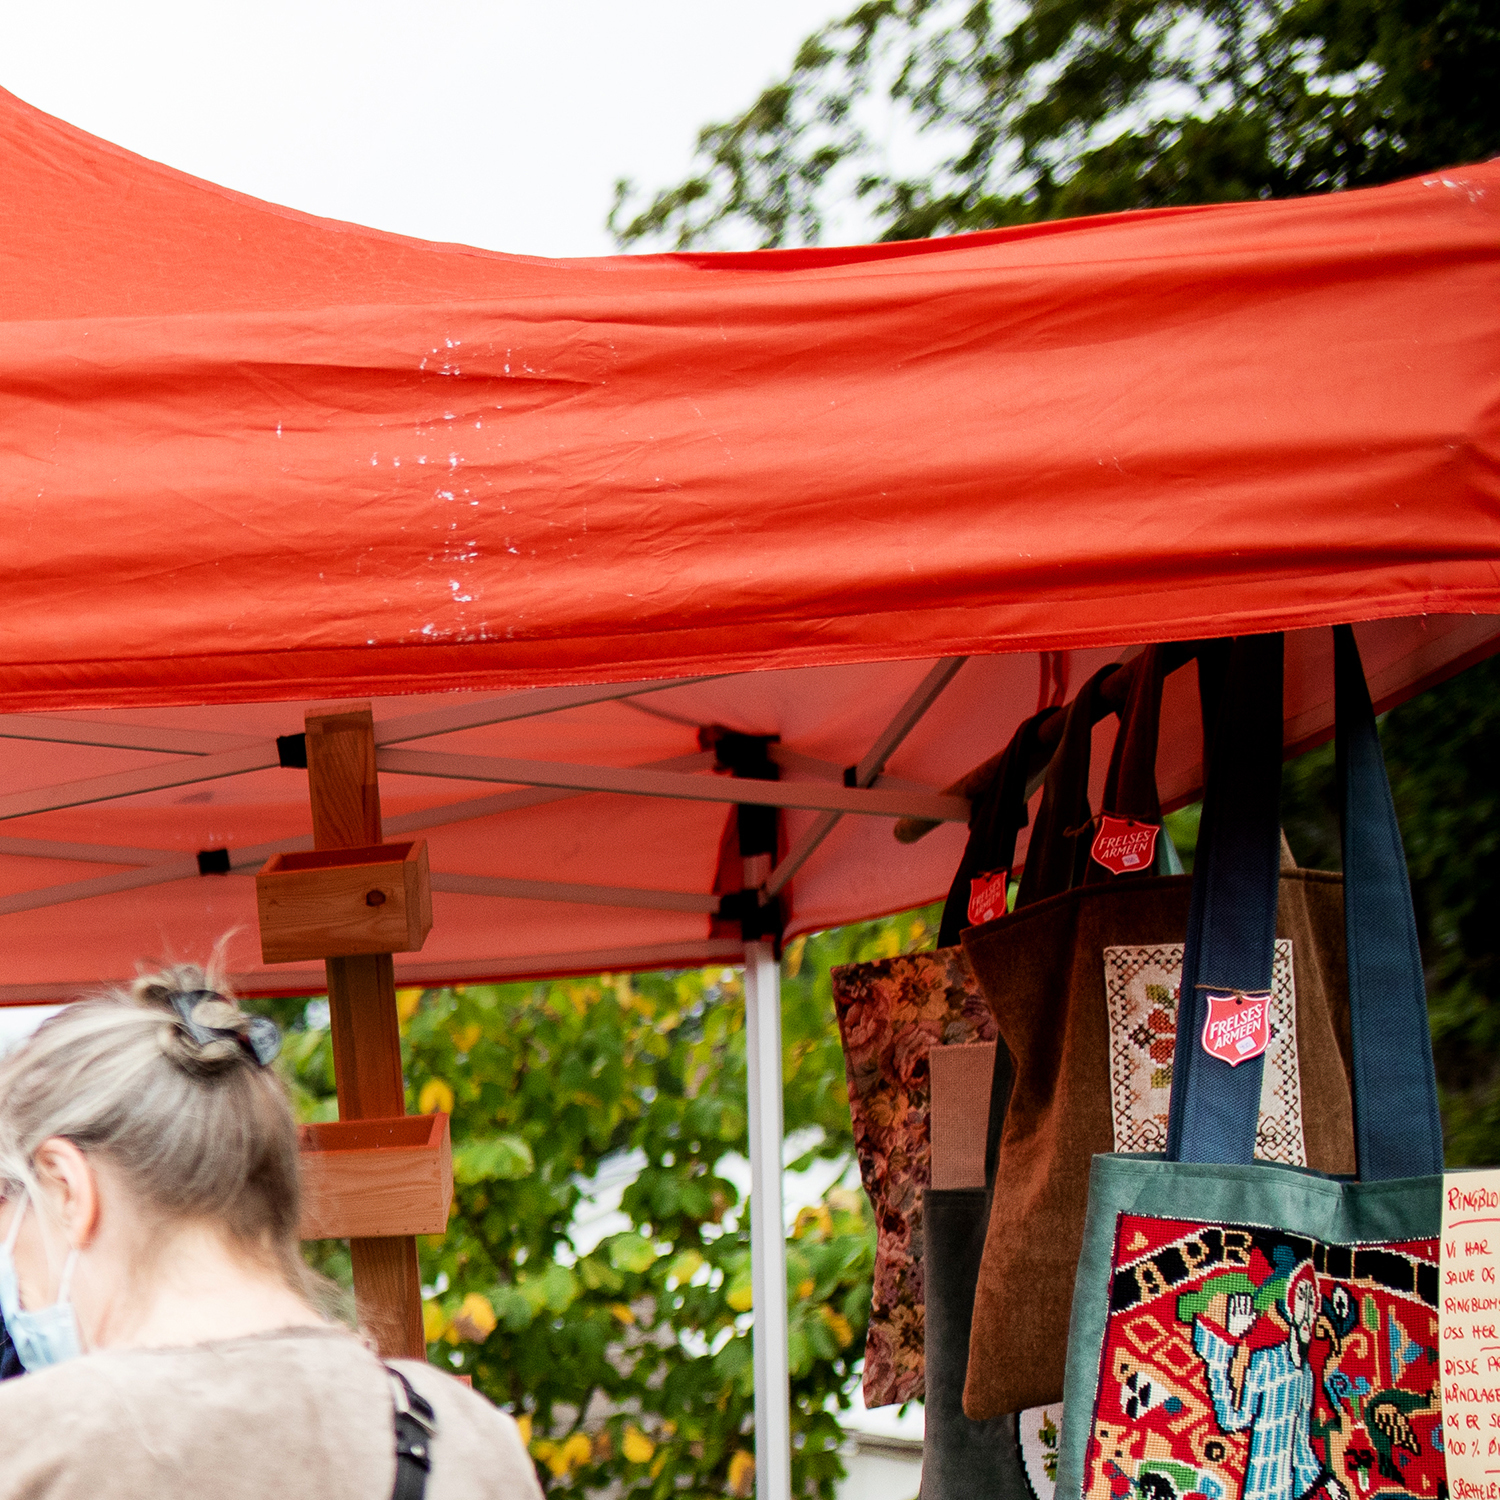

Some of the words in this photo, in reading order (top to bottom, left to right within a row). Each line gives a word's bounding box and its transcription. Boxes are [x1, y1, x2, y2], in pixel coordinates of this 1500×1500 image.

[1101, 842, 1149, 860] ARMEEN
[1213, 1018, 1262, 1051] ARMEEN
[1465, 1239, 1493, 1257] HAR
[1445, 1269, 1475, 1286] SALVE
[1481, 1267, 1496, 1284] OG
[1443, 1326, 1464, 1341] OSS
[1472, 1324, 1499, 1340] HER
[1447, 1413, 1460, 1431] OG
[1466, 1413, 1481, 1431] ER
[1453, 1477, 1500, 1500] SÅRHELE
